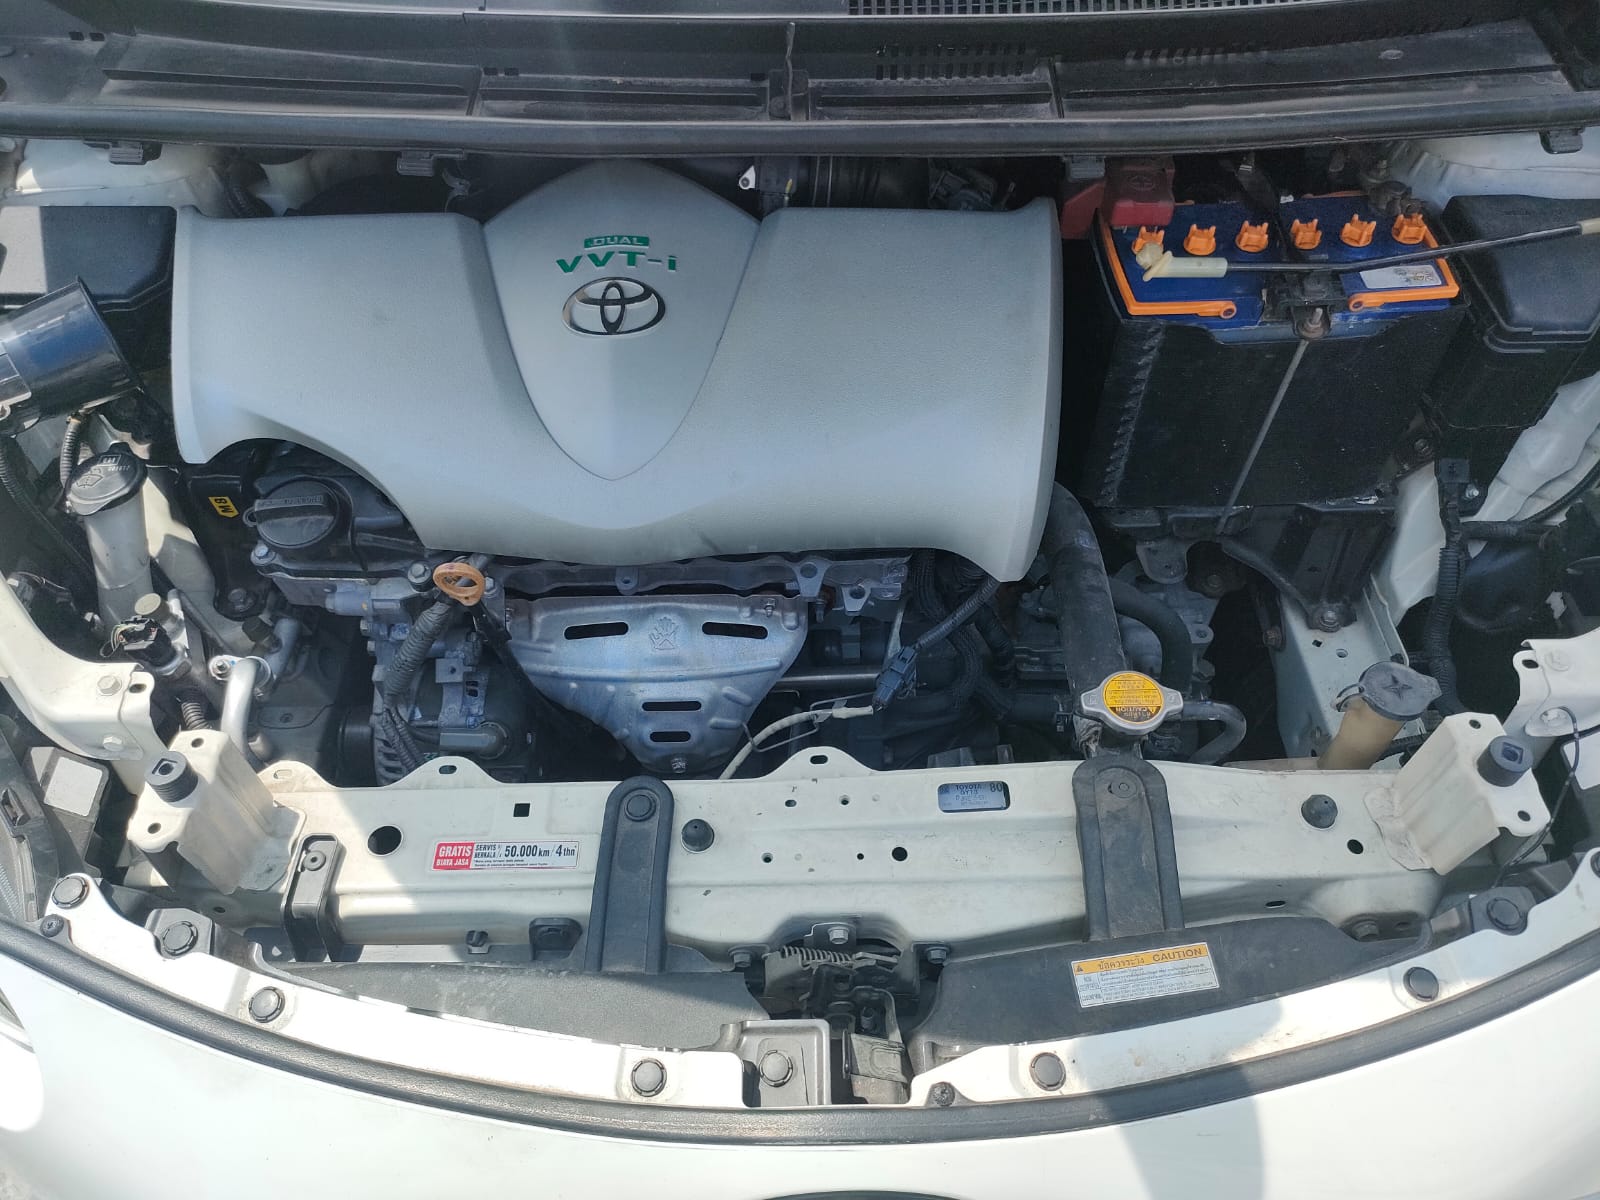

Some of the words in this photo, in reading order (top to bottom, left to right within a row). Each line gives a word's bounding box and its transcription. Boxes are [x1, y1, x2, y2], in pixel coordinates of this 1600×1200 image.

[592, 236, 643, 246] DUAL
[556, 251, 677, 273] VVT-i
[990, 782, 1003, 792] 80
[438, 844, 473, 858] GRATIS
[475, 844, 497, 852] SERVIS
[504, 845, 538, 858] 50.000
[538, 848, 550, 858] km
[555, 844, 563, 857] 4
[436, 858, 453, 867] BIAYA
[453, 858, 469, 867] JASA
[1152, 948, 1202, 962] CAUTION
